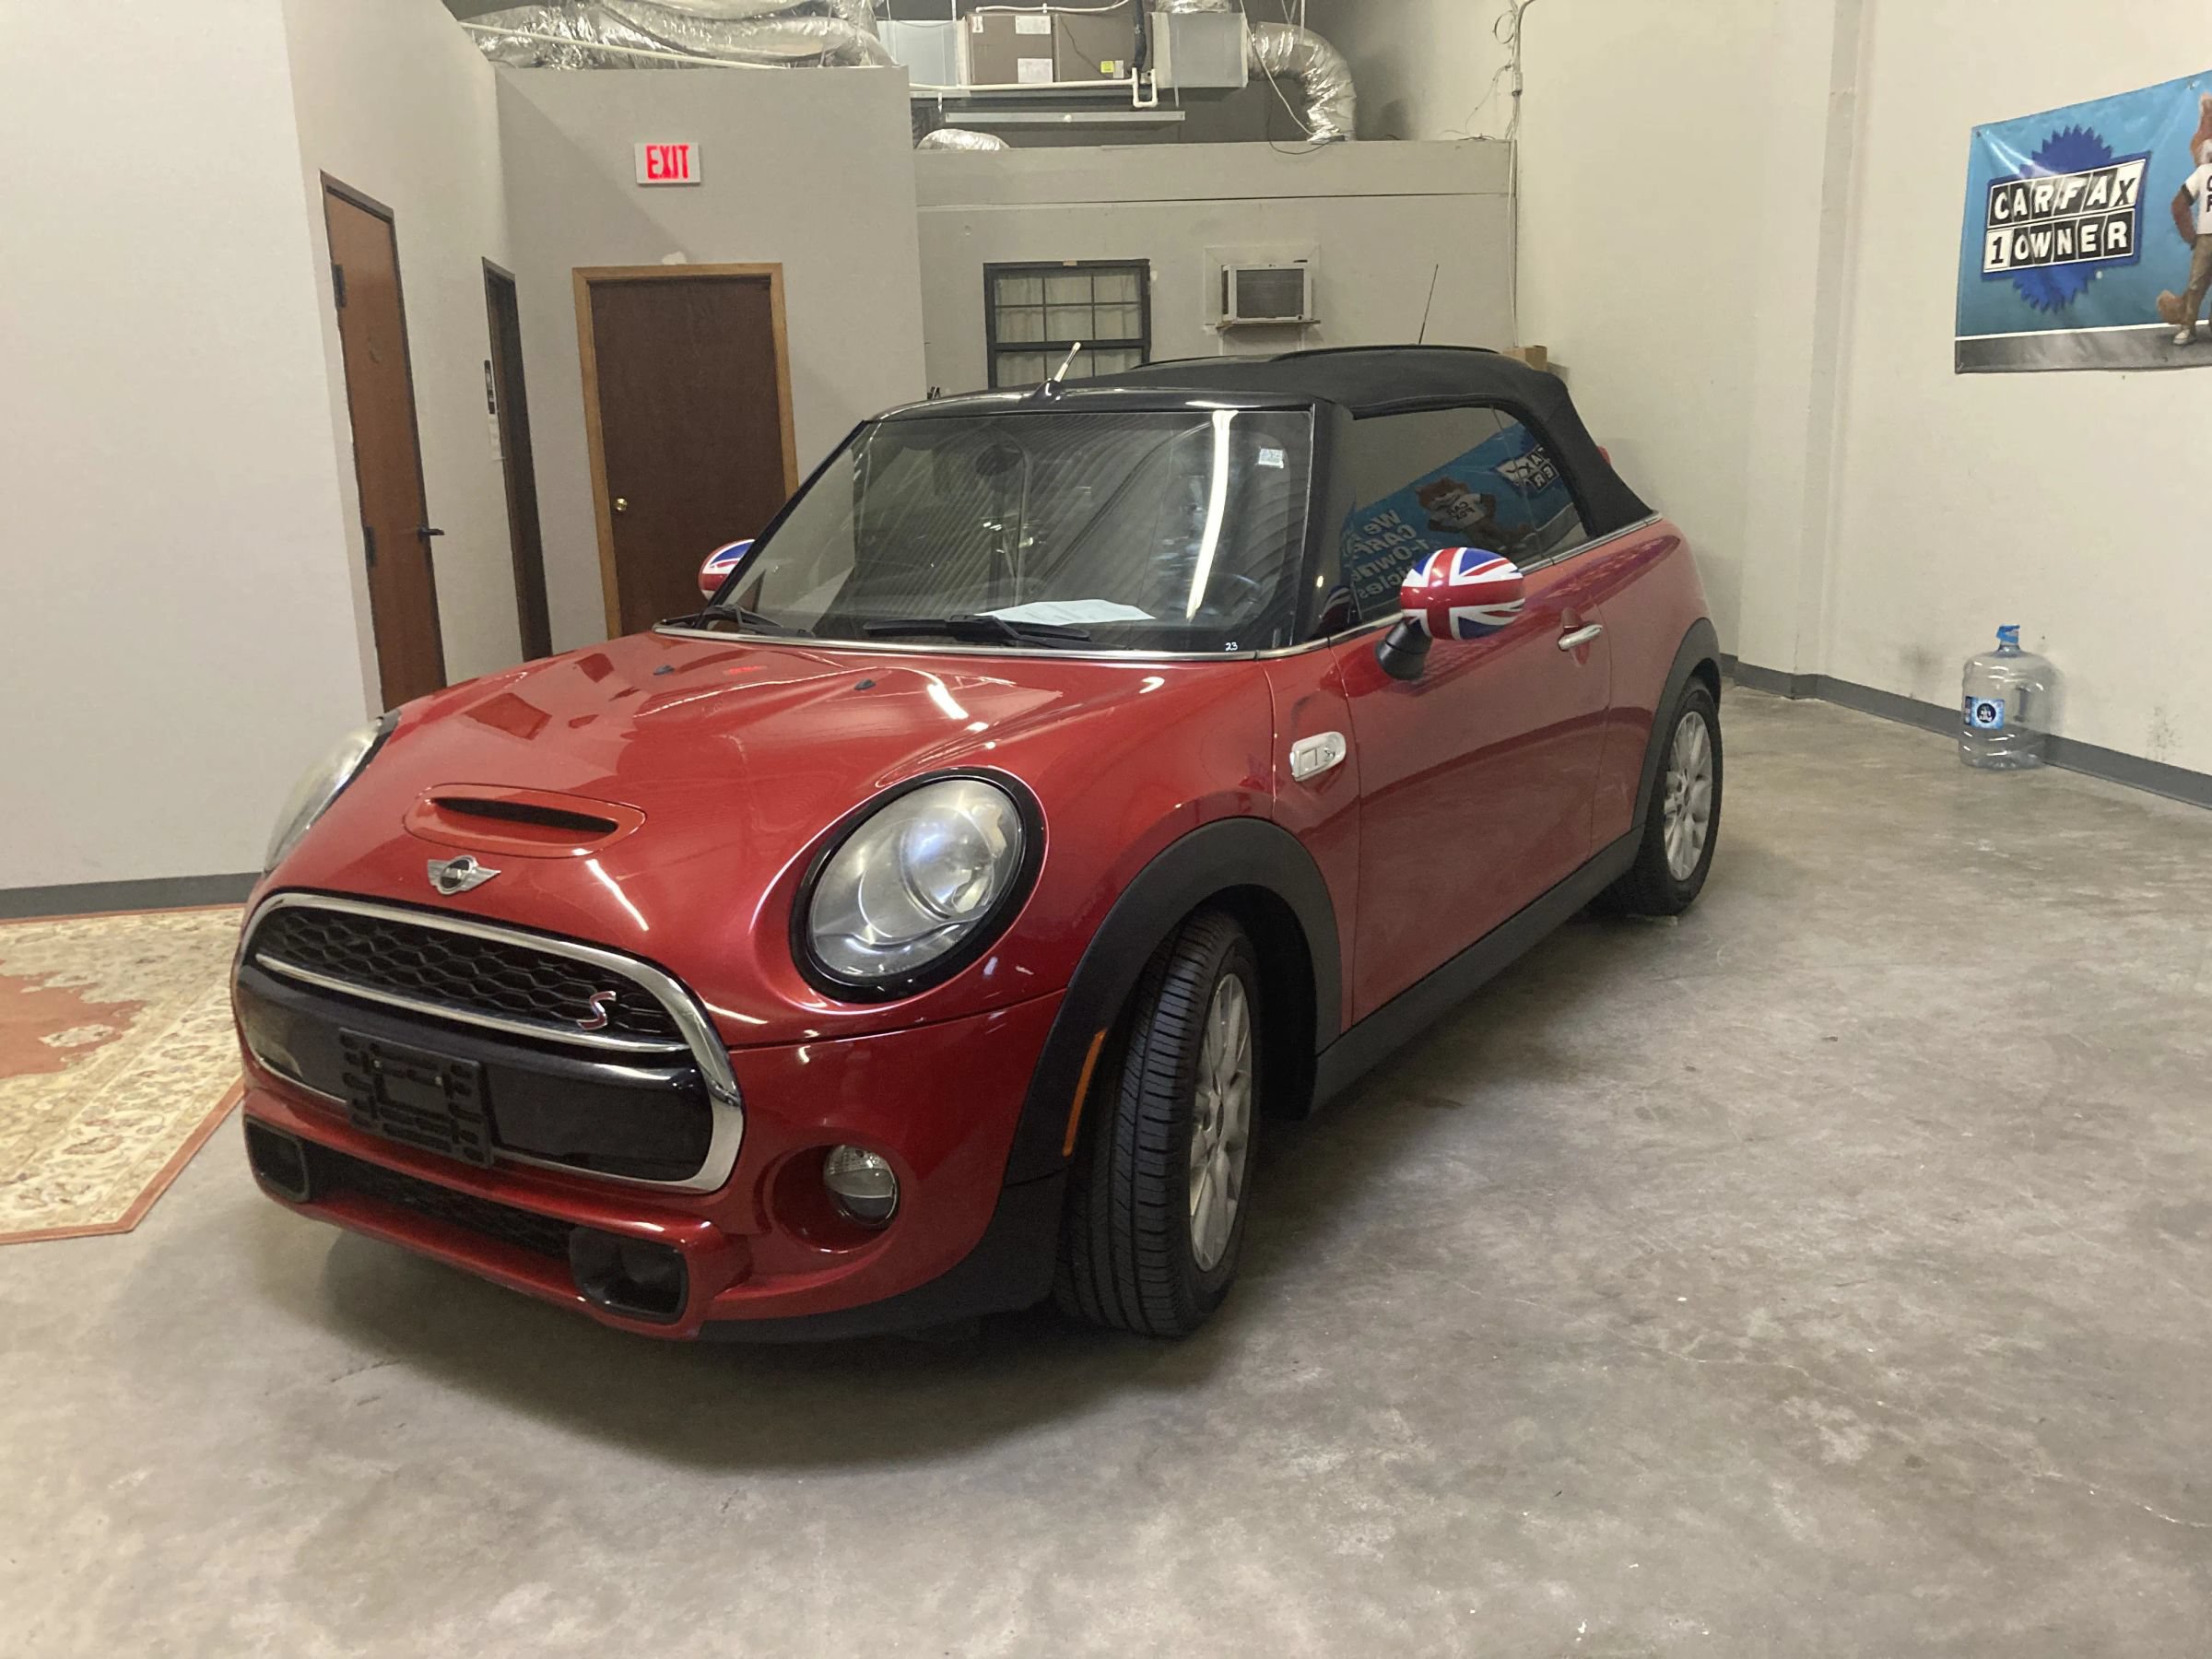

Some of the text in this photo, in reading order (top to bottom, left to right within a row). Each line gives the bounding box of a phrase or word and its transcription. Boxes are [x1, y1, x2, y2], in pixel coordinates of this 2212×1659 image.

[646, 145, 689, 180] EXIT
[1994, 175, 2137, 220] CARFAX
[1225, 641, 1238, 652] 23
[576, 990, 617, 1030] S
